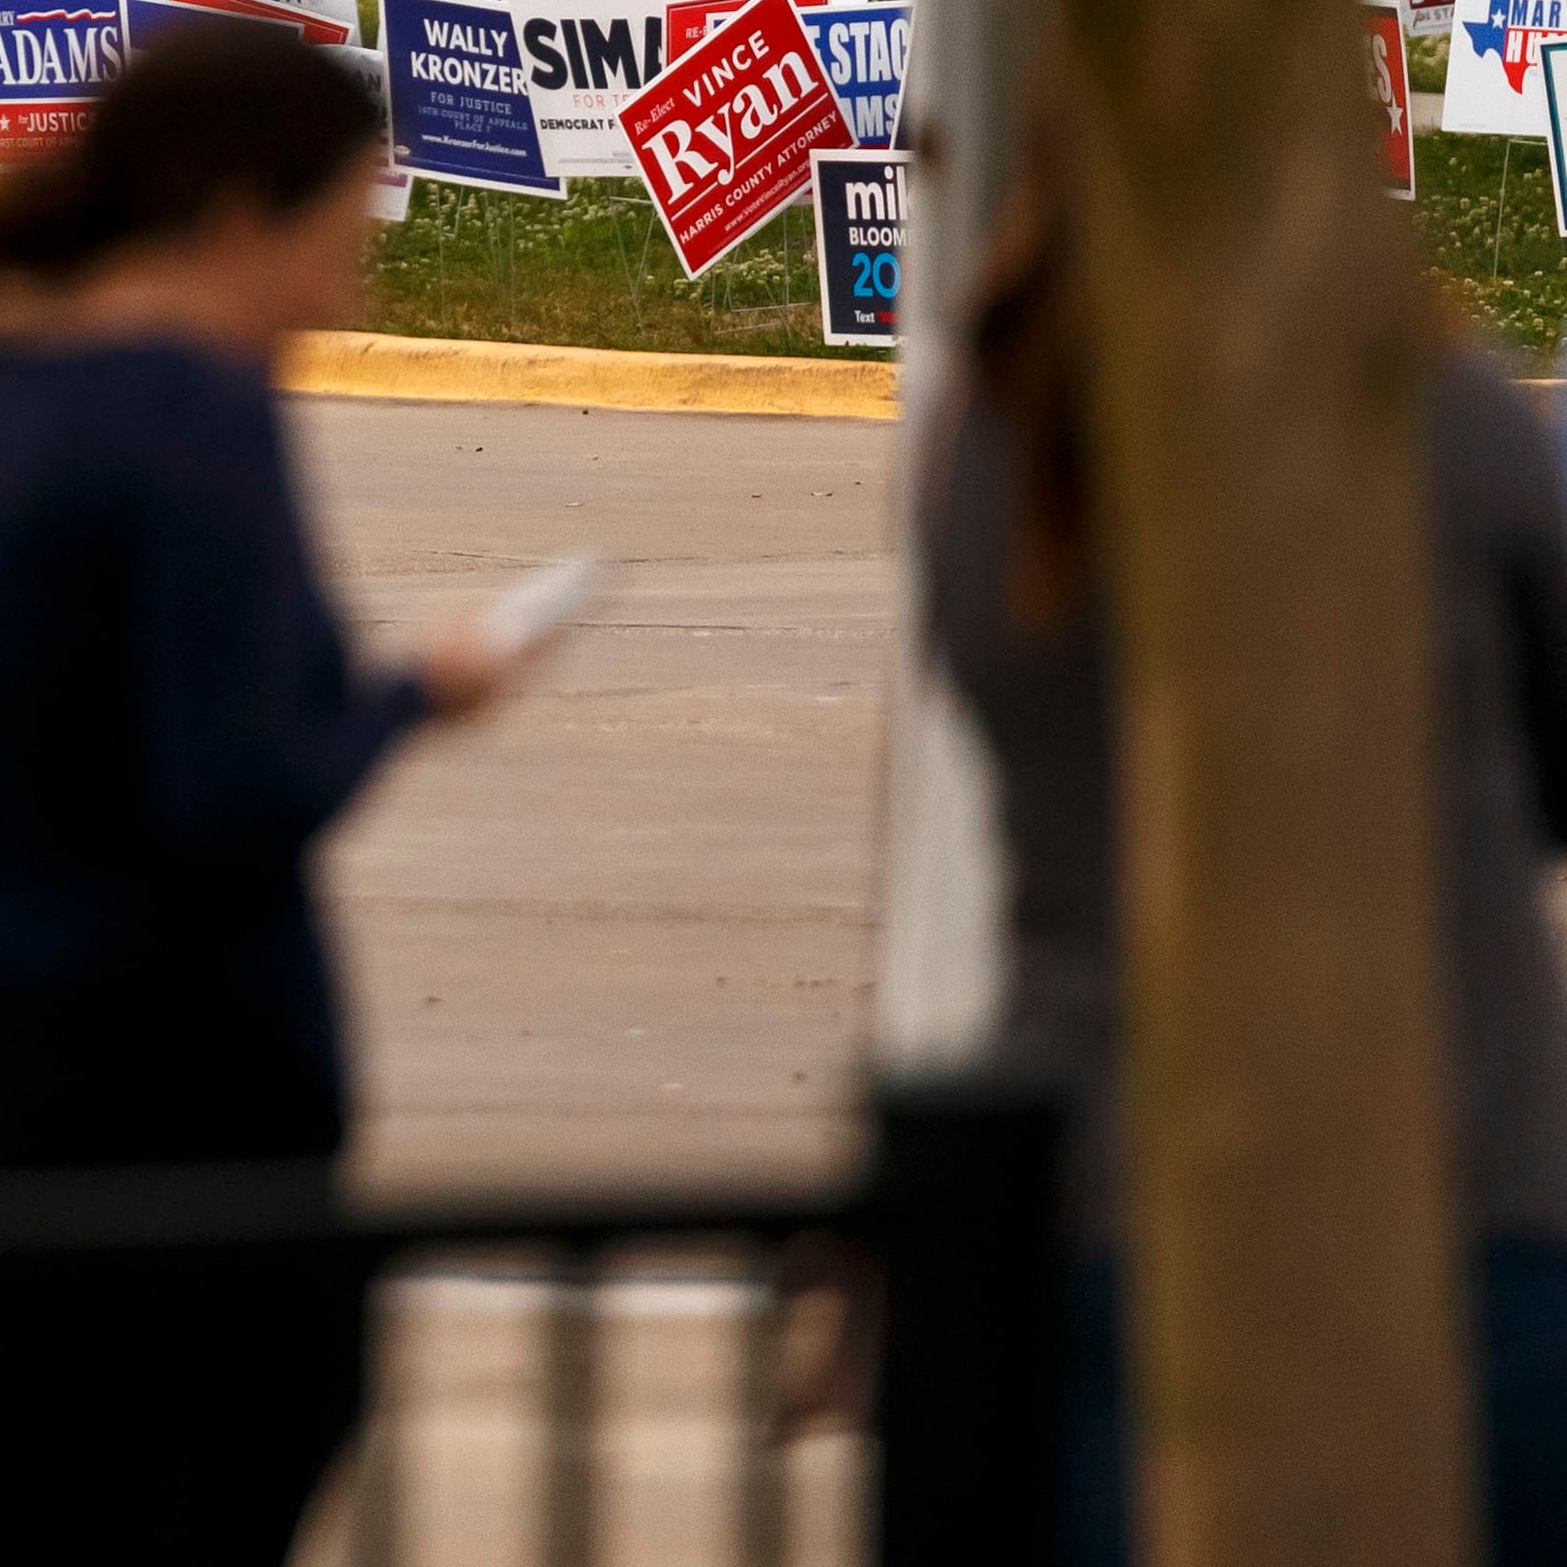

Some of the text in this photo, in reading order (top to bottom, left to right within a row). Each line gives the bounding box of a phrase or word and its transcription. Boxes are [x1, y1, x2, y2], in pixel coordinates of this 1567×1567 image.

[423, 18, 508, 58] WALLY
[410, 51, 529, 97] KRONZER
[634, 30, 771, 136] Re-Elect VINCE
[430, 91, 513, 115] FOR JUSTICE
[572, 93, 607, 108] FOR
[441, 109, 529, 131] COURT OF APPEALS
[454, 120, 483, 133] PLACE
[540, 118, 605, 131] DEMOCRAT
[641, 50, 820, 205] Ryan
[679, 110, 839, 244] HARRIS COUNTY ATTORNEY
[853, 309, 876, 323] Text
